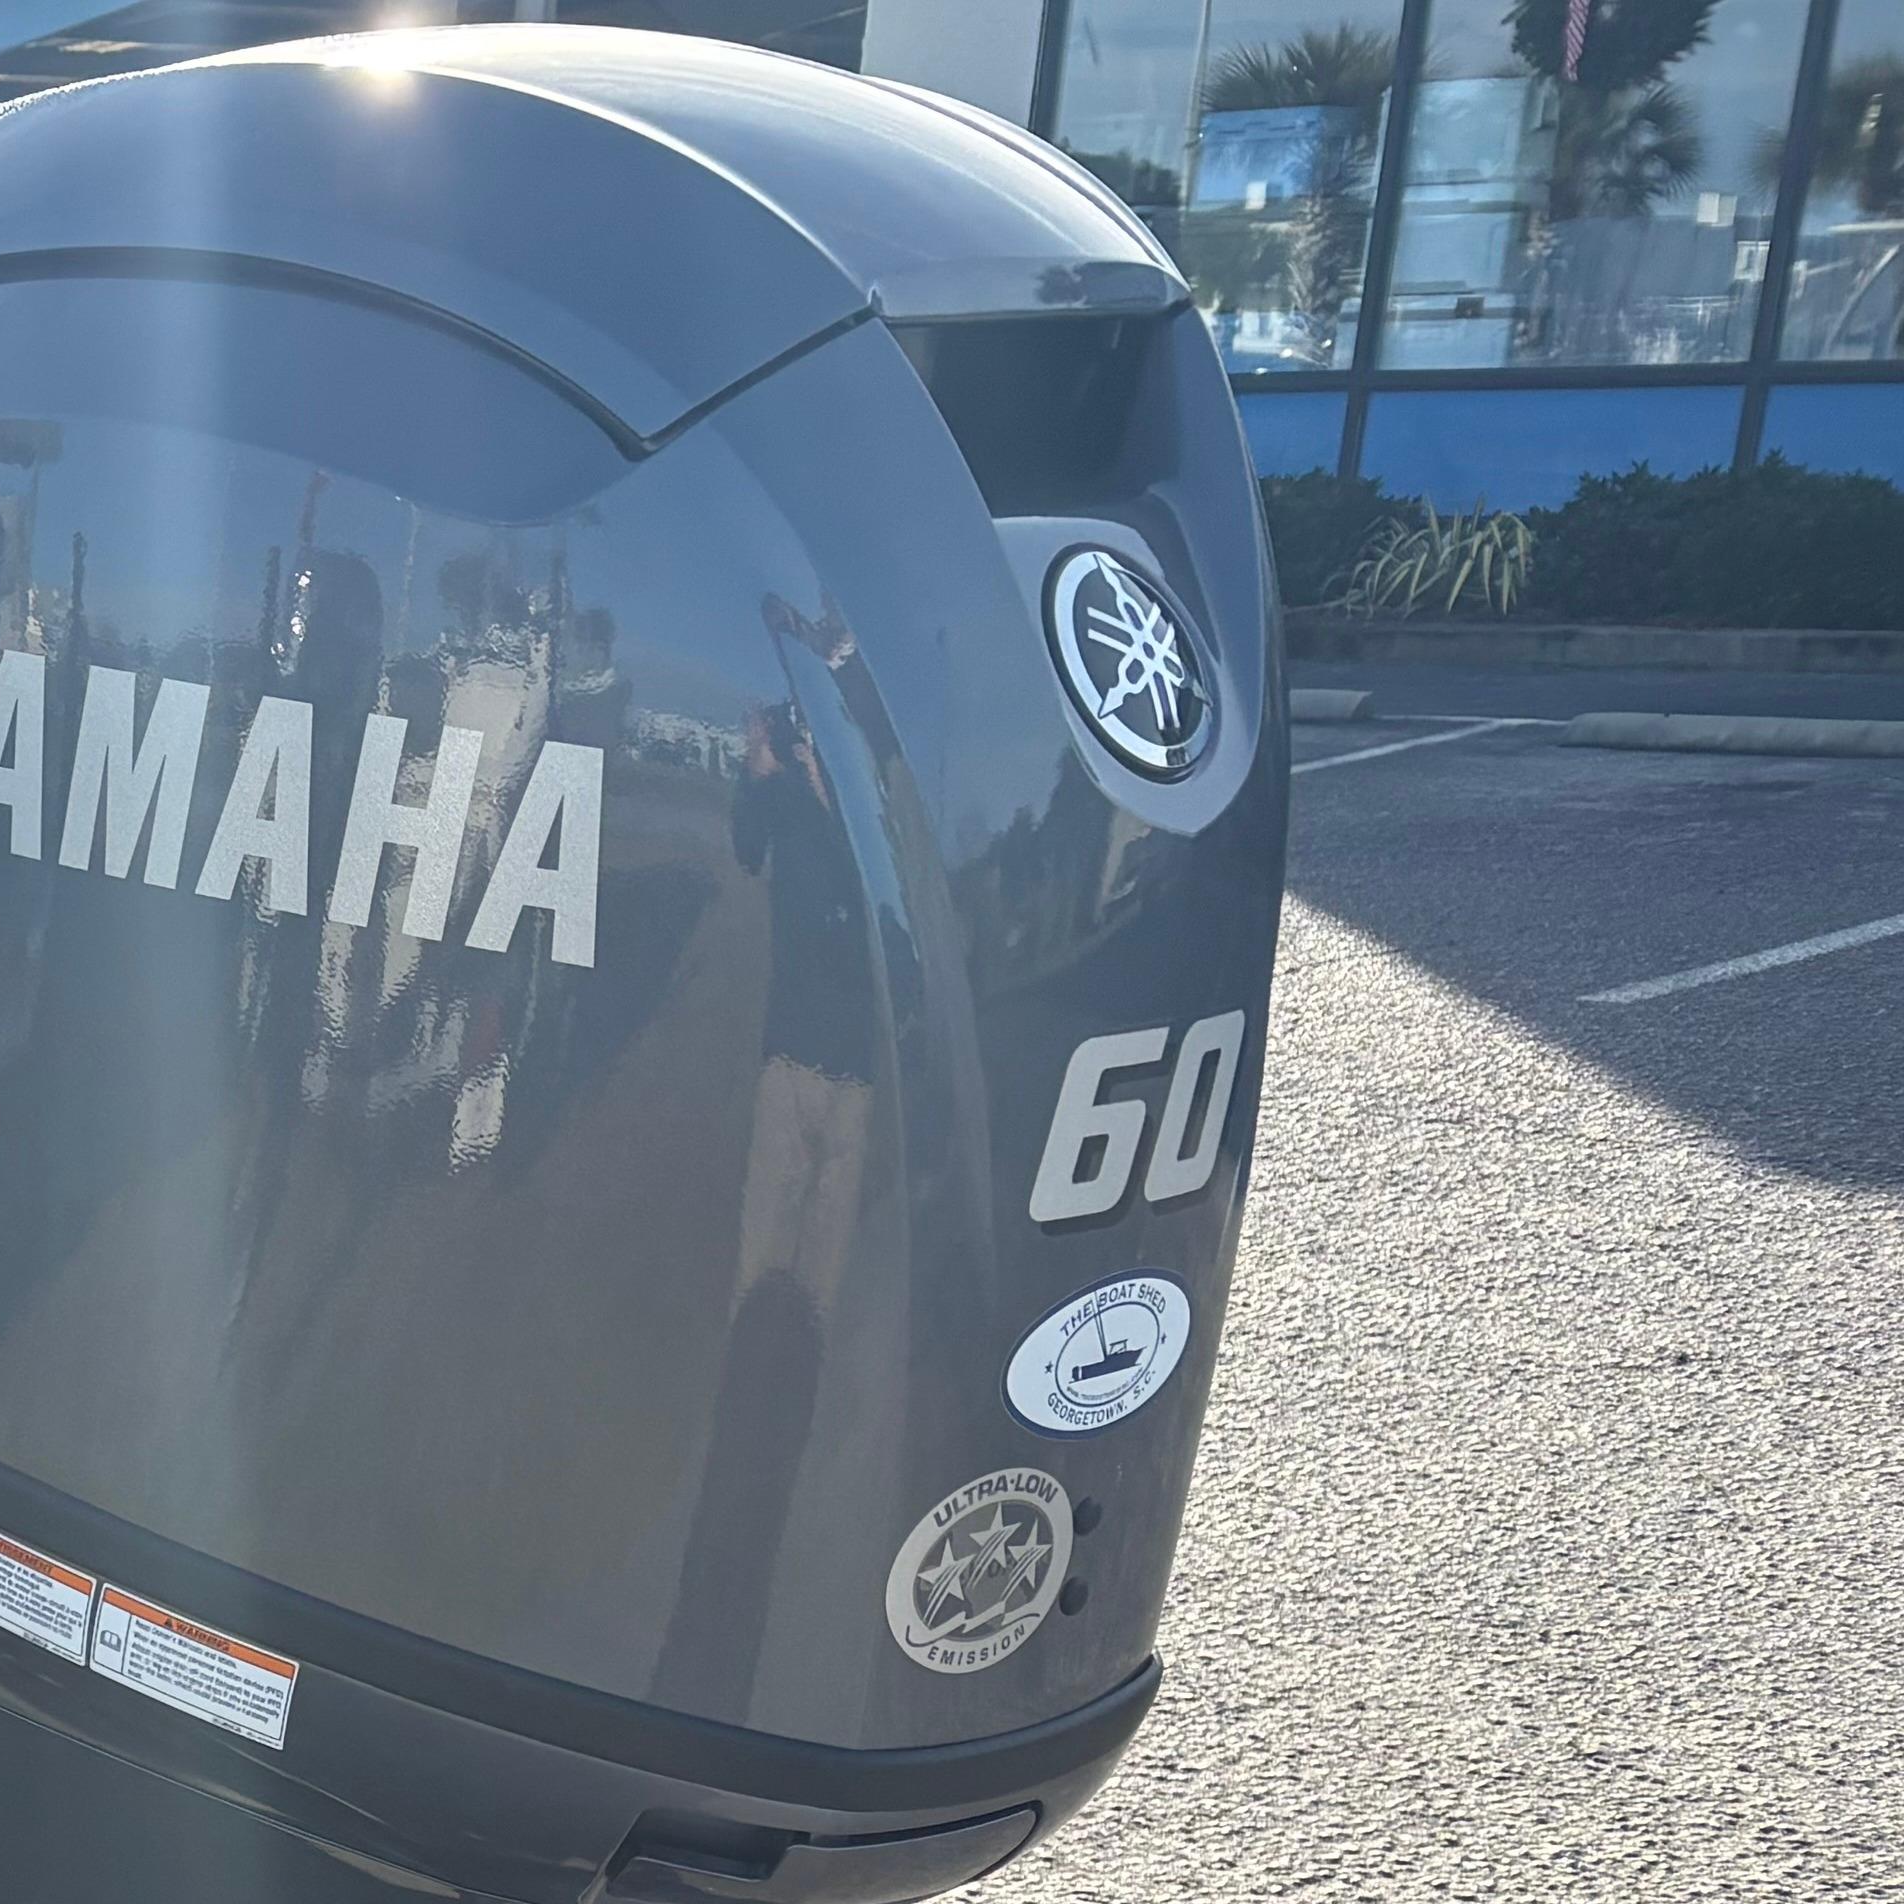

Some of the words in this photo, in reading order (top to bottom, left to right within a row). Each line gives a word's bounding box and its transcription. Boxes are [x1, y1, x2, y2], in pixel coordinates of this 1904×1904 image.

[1029, 1009, 1245, 1222] 60
[1060, 1299, 1093, 1337] THE
[1097, 1283, 1136, 1306] BOAT
[1138, 1284, 1166, 1314] SHED
[927, 1624, 1025, 1666] EMISSION
